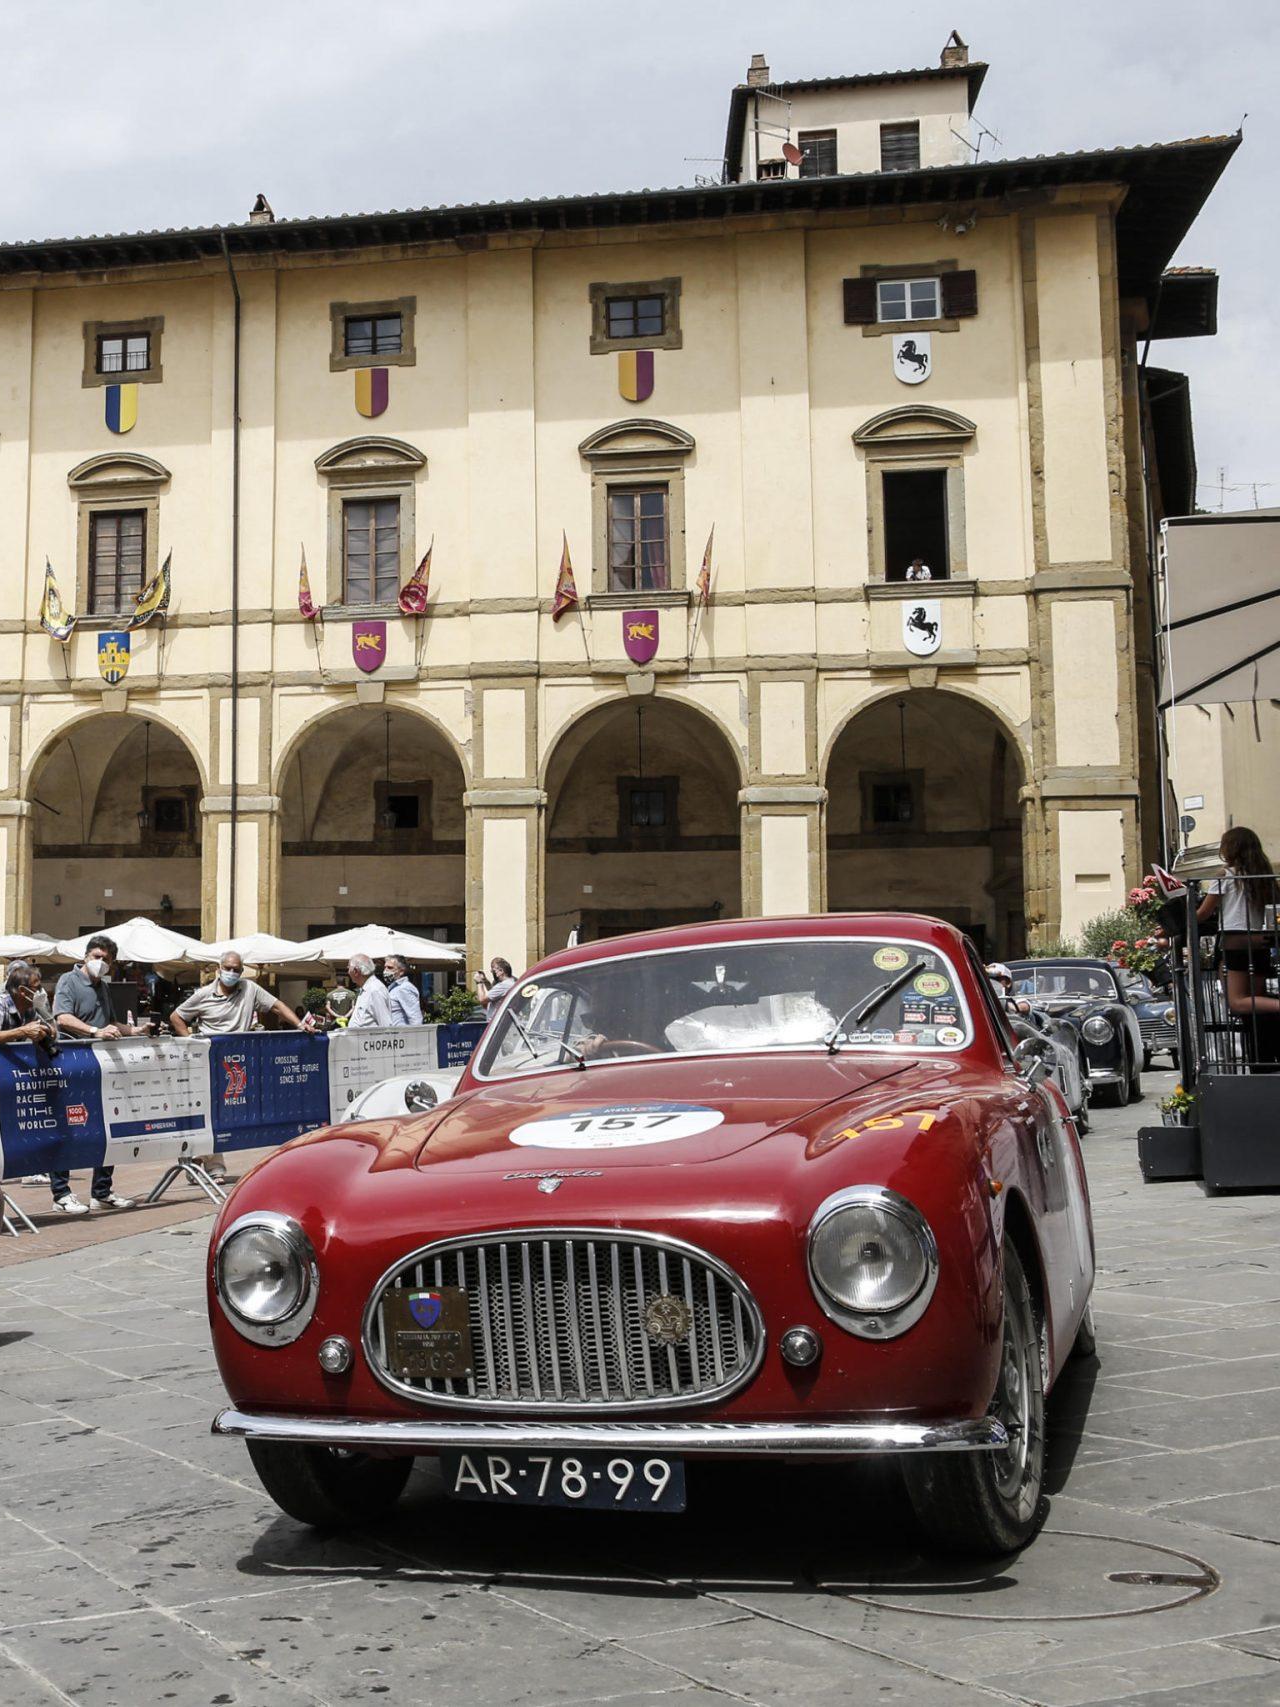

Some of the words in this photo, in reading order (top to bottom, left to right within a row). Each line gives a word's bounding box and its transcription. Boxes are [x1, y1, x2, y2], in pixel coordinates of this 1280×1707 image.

[363, 1039, 405, 1052] CHOPARD
[223, 1054, 246, 1063] 1000
[274, 1056, 299, 1064] CROSSING
[12, 1068, 38, 1078] THE
[40, 1067, 63, 1077] MOST
[291, 1065, 301, 1073] THE
[302, 1063, 320, 1072] FUTURE
[16, 1079, 68, 1091] BEAUTIFUL
[280, 1076, 295, 1084] SINCE
[16, 1093, 47, 1104] RACE
[224, 1096, 247, 1106] MIGLIA
[17, 1108, 26, 1117] IN
[28, 1106, 53, 1117] THE
[18, 1119, 58, 1130] WORLD
[570, 1114, 683, 1133] 157
[453, 1454, 672, 1502] AR-78-99
